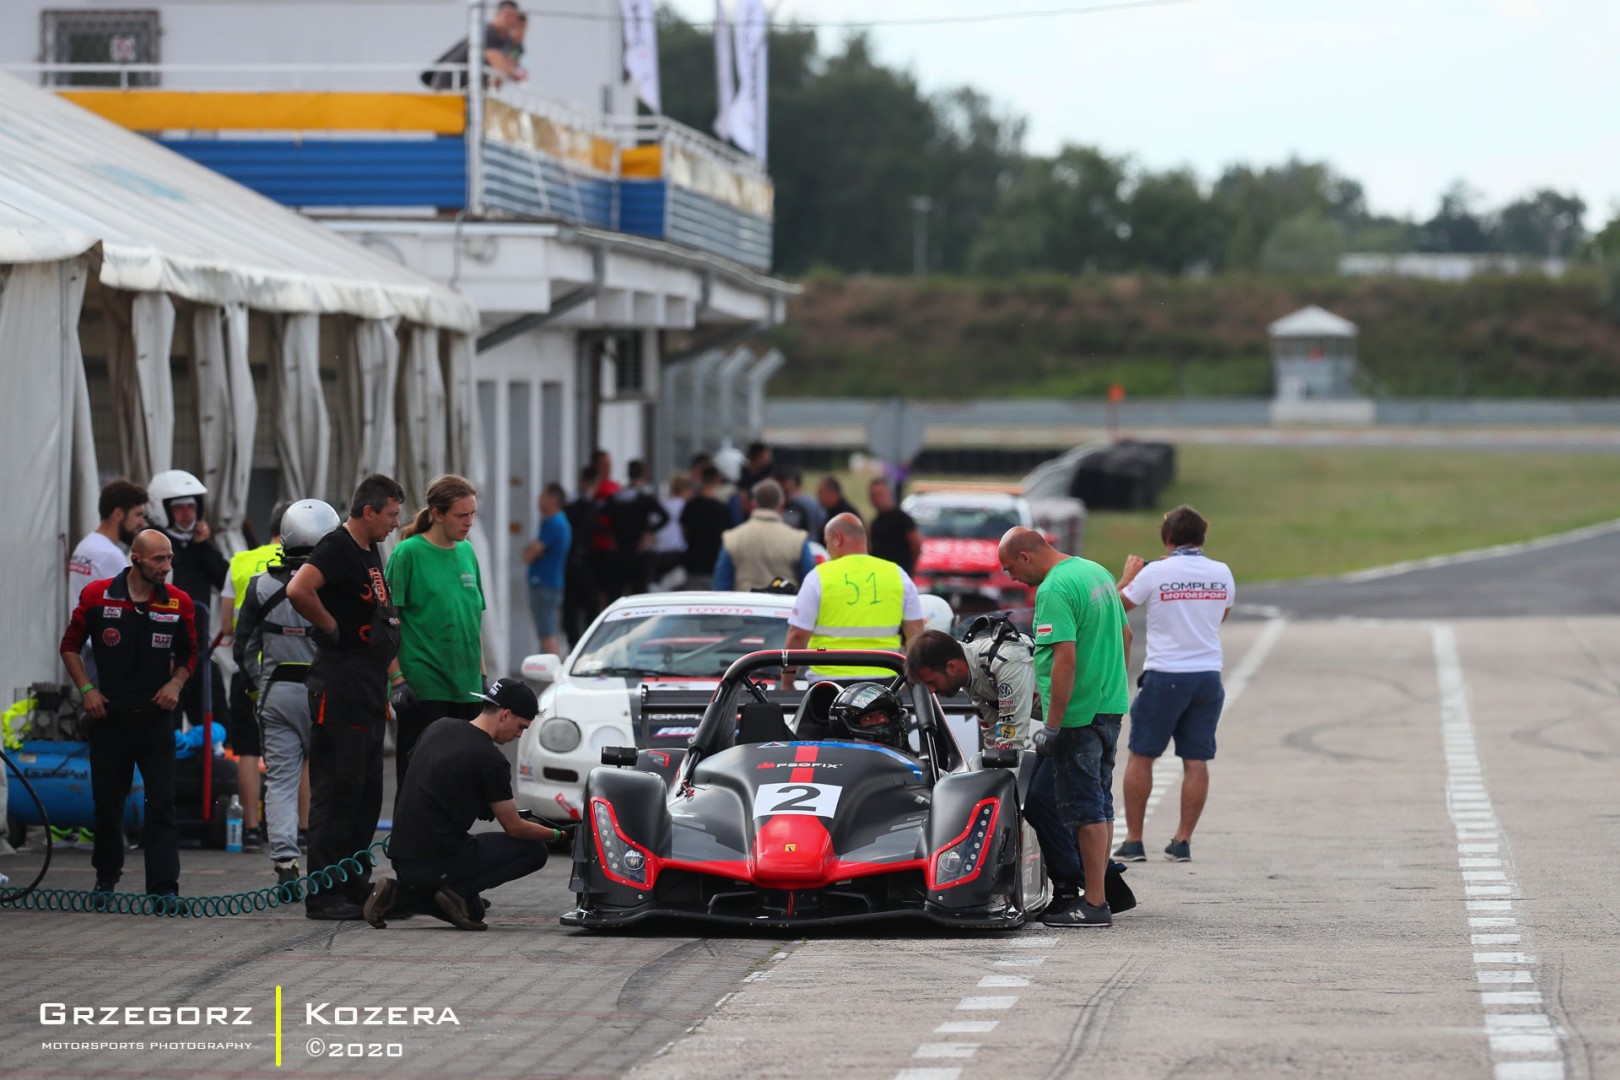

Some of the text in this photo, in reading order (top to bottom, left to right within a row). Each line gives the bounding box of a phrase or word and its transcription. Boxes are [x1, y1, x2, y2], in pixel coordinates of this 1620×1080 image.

[844, 571, 883, 606] 51
[1159, 581, 1228, 592] COMPLEX
[1162, 591, 1227, 601] MOTORSPORT
[687, 606, 753, 615] TOYOTA
[637, 713, 705, 721] COMPL
[769, 784, 822, 812] 2
